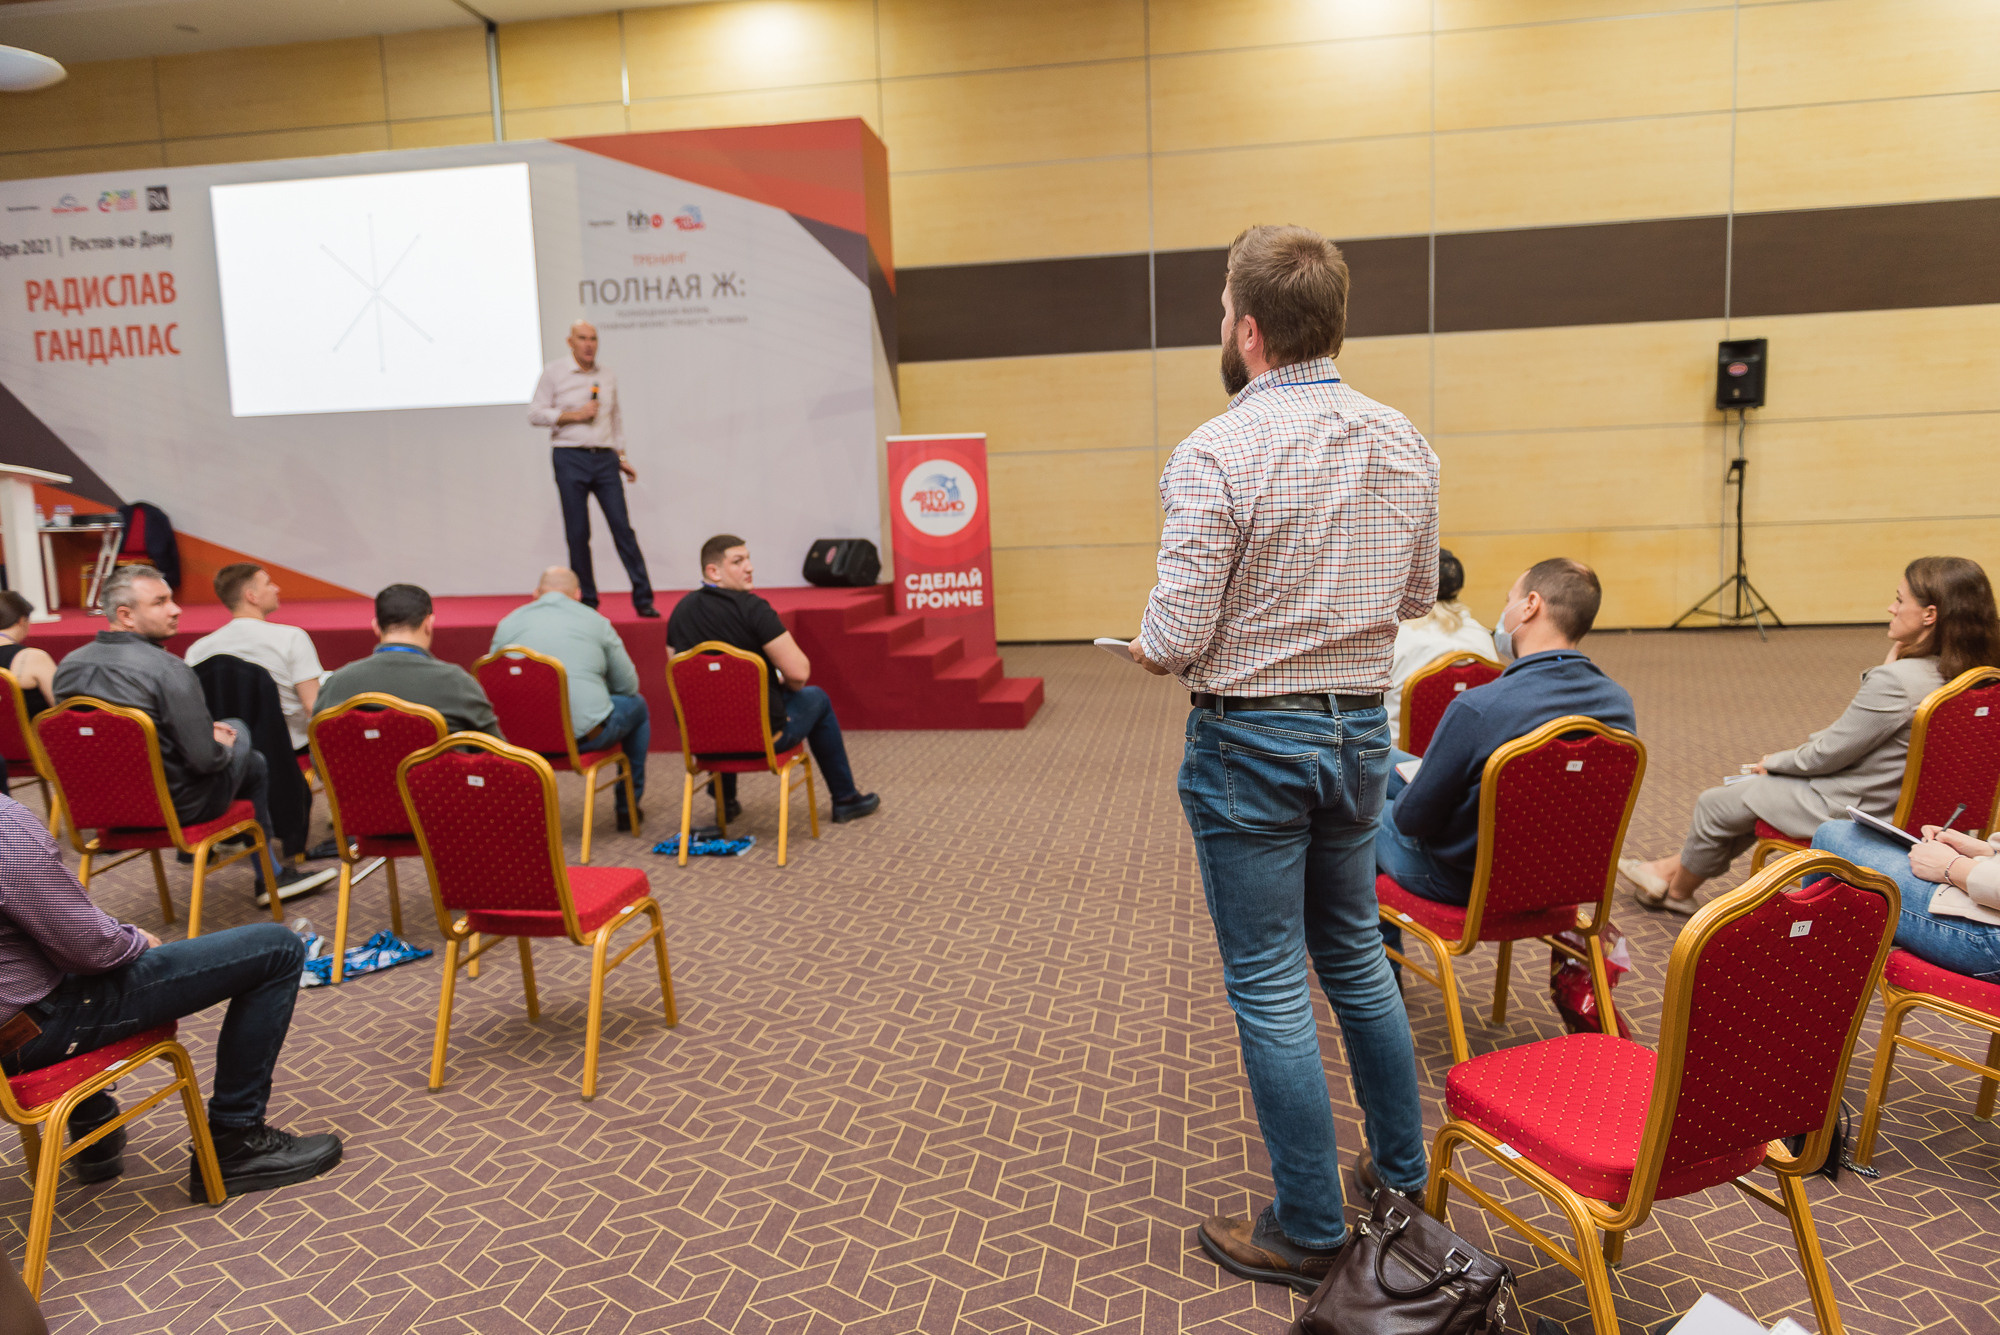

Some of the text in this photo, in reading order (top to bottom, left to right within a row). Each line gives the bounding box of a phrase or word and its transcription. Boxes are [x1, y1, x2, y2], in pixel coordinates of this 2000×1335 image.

[21, 238, 52, 255] 2021
[25, 271, 177, 316] РАДИСЛАВ
[578, 270, 747, 306] ПОЛНАЯ Ж:
[34, 322, 181, 366] ГАНДАПАС
[905, 568, 982, 591] СДЕЛАЙ
[906, 590, 983, 609] ГРОМЧЕ
